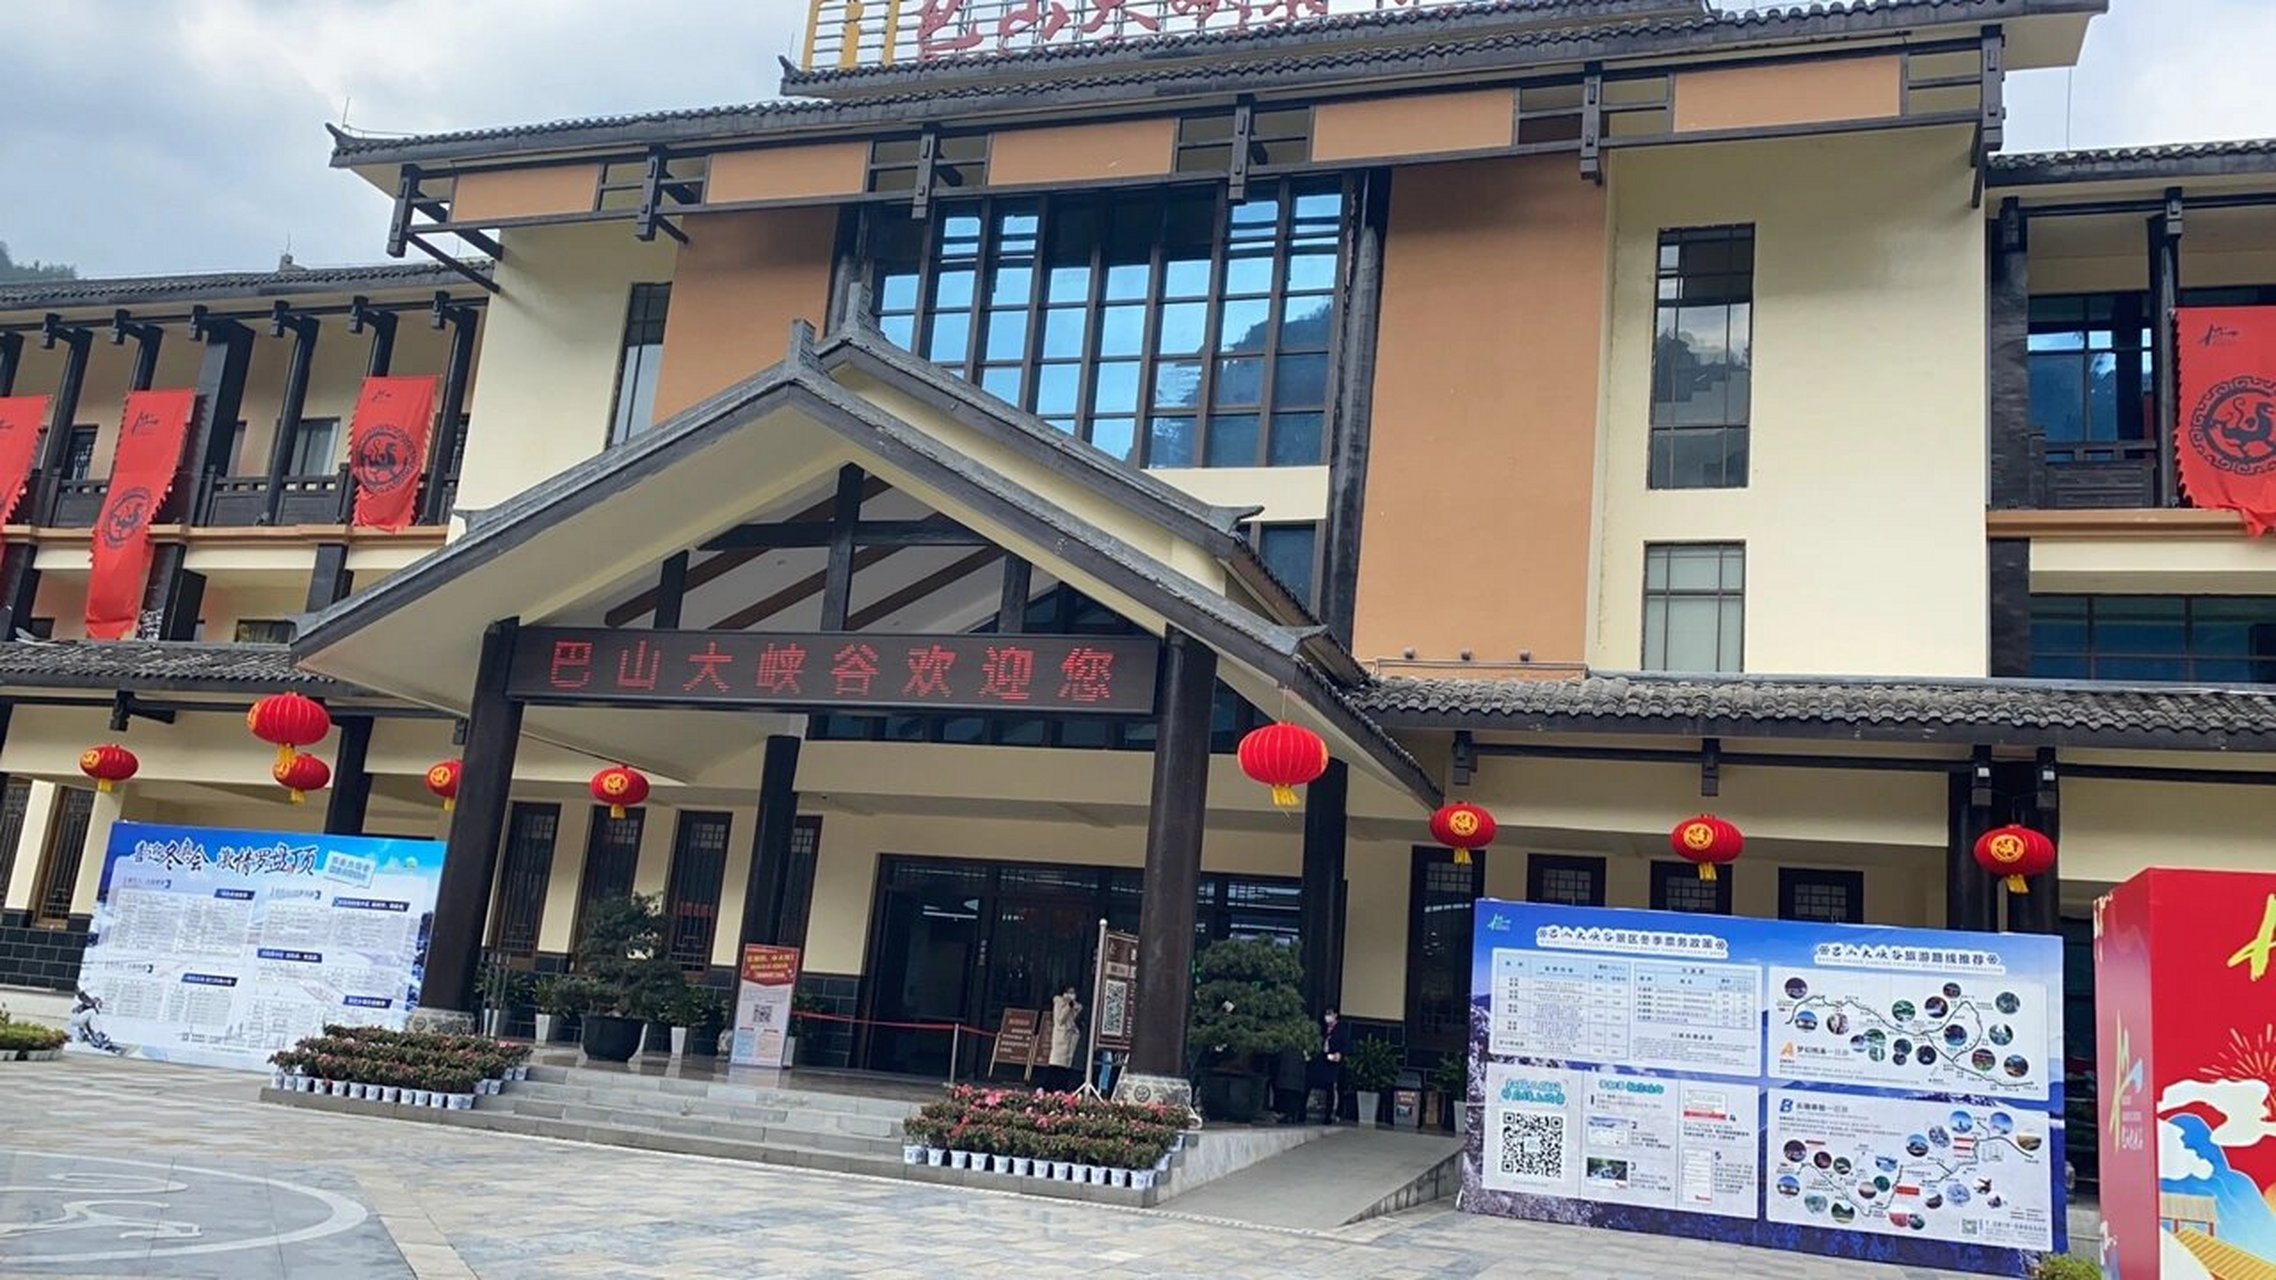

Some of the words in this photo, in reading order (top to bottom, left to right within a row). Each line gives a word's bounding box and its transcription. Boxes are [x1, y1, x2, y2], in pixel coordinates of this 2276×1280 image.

[549, 640, 1114, 701] 巴山大峡谷欢迎您
[1549, 929, 1714, 949] 巴山大峡谷景区冬季票务政策
[1832, 945, 1986, 966] 巴山大峡谷旅游路线推荐
[1780, 1041, 1794, 1057] A
[1779, 1098, 1794, 1113] B
